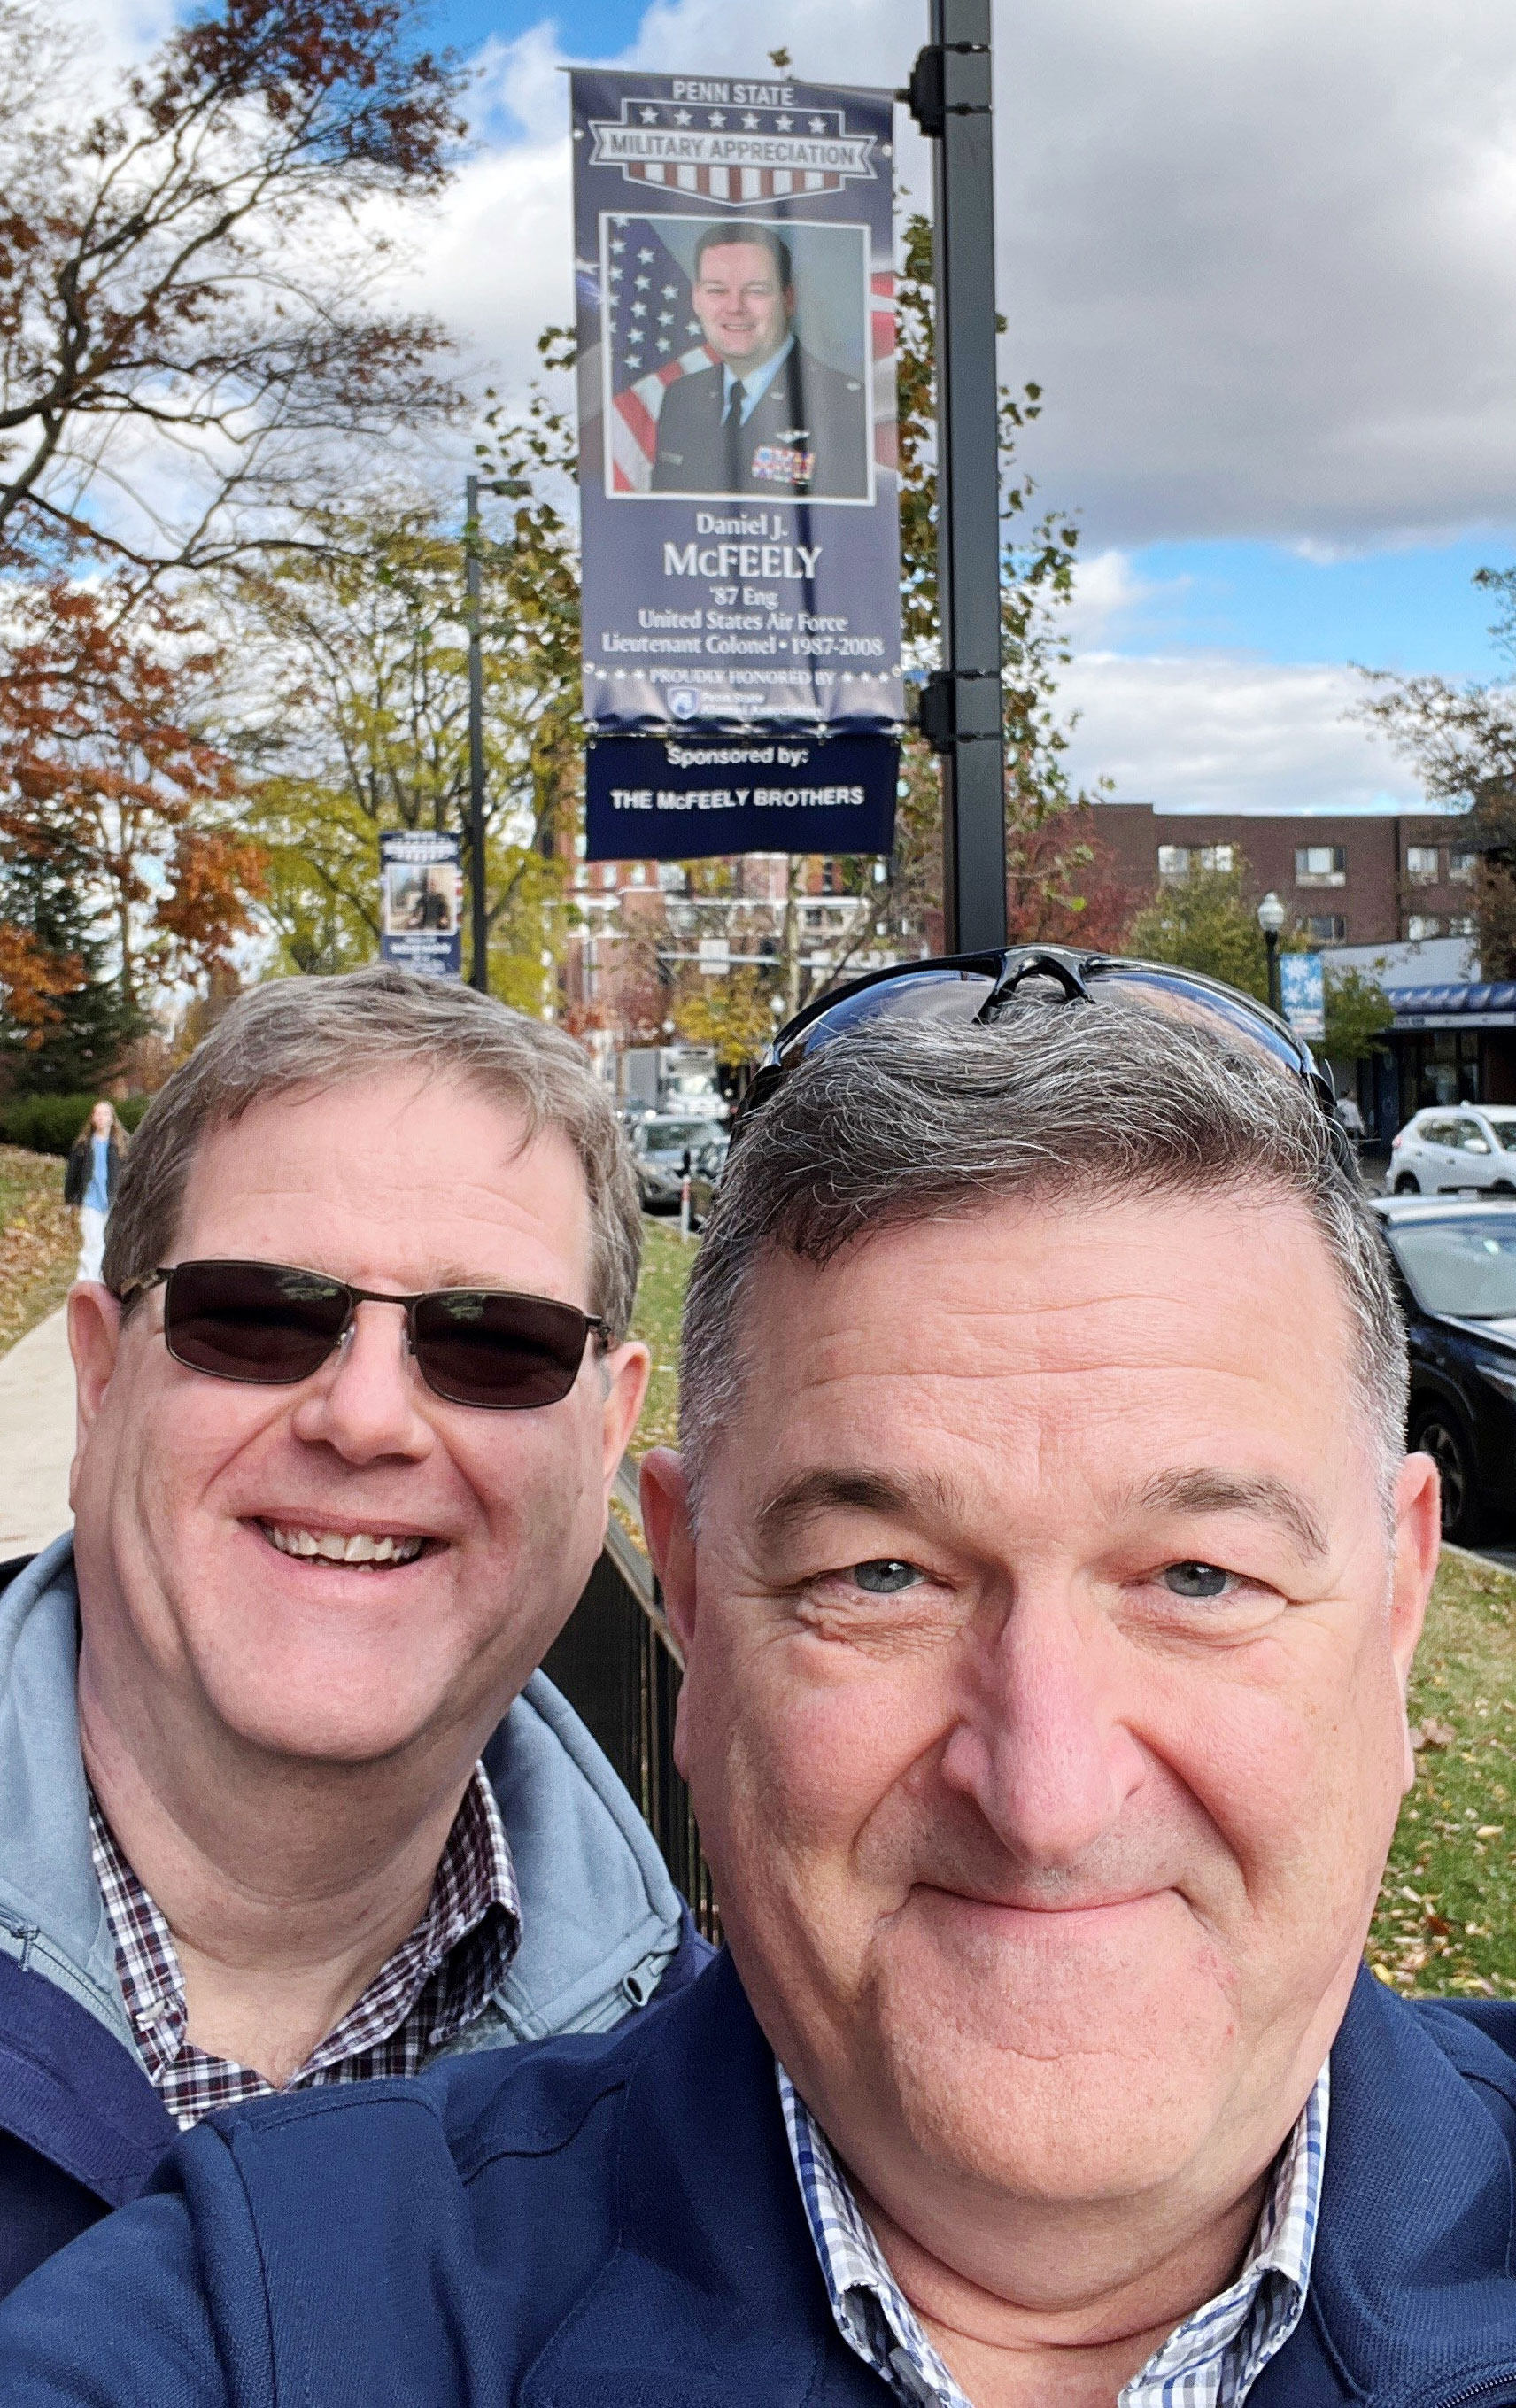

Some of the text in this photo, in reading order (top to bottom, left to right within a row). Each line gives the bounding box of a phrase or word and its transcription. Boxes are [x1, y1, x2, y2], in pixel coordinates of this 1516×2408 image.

[673, 81, 794, 106] PENN STATE
[610, 134, 855, 166] MILITARY APPRECIATION
[696, 513, 788, 540] Daniel J.
[664, 542, 823, 578] McFEELY
[743, 587, 779, 610] Eng
[638, 608, 848, 632] United States Air Force
[602, 632, 885, 656] Lieutenant Colonel 1987-2008
[729, 669, 811, 685] HONORED
[815, 670, 836, 685] BY
[667, 747, 809, 768] Sponsored by:
[610, 786, 865, 810] THE McFEELY BROTHERS
